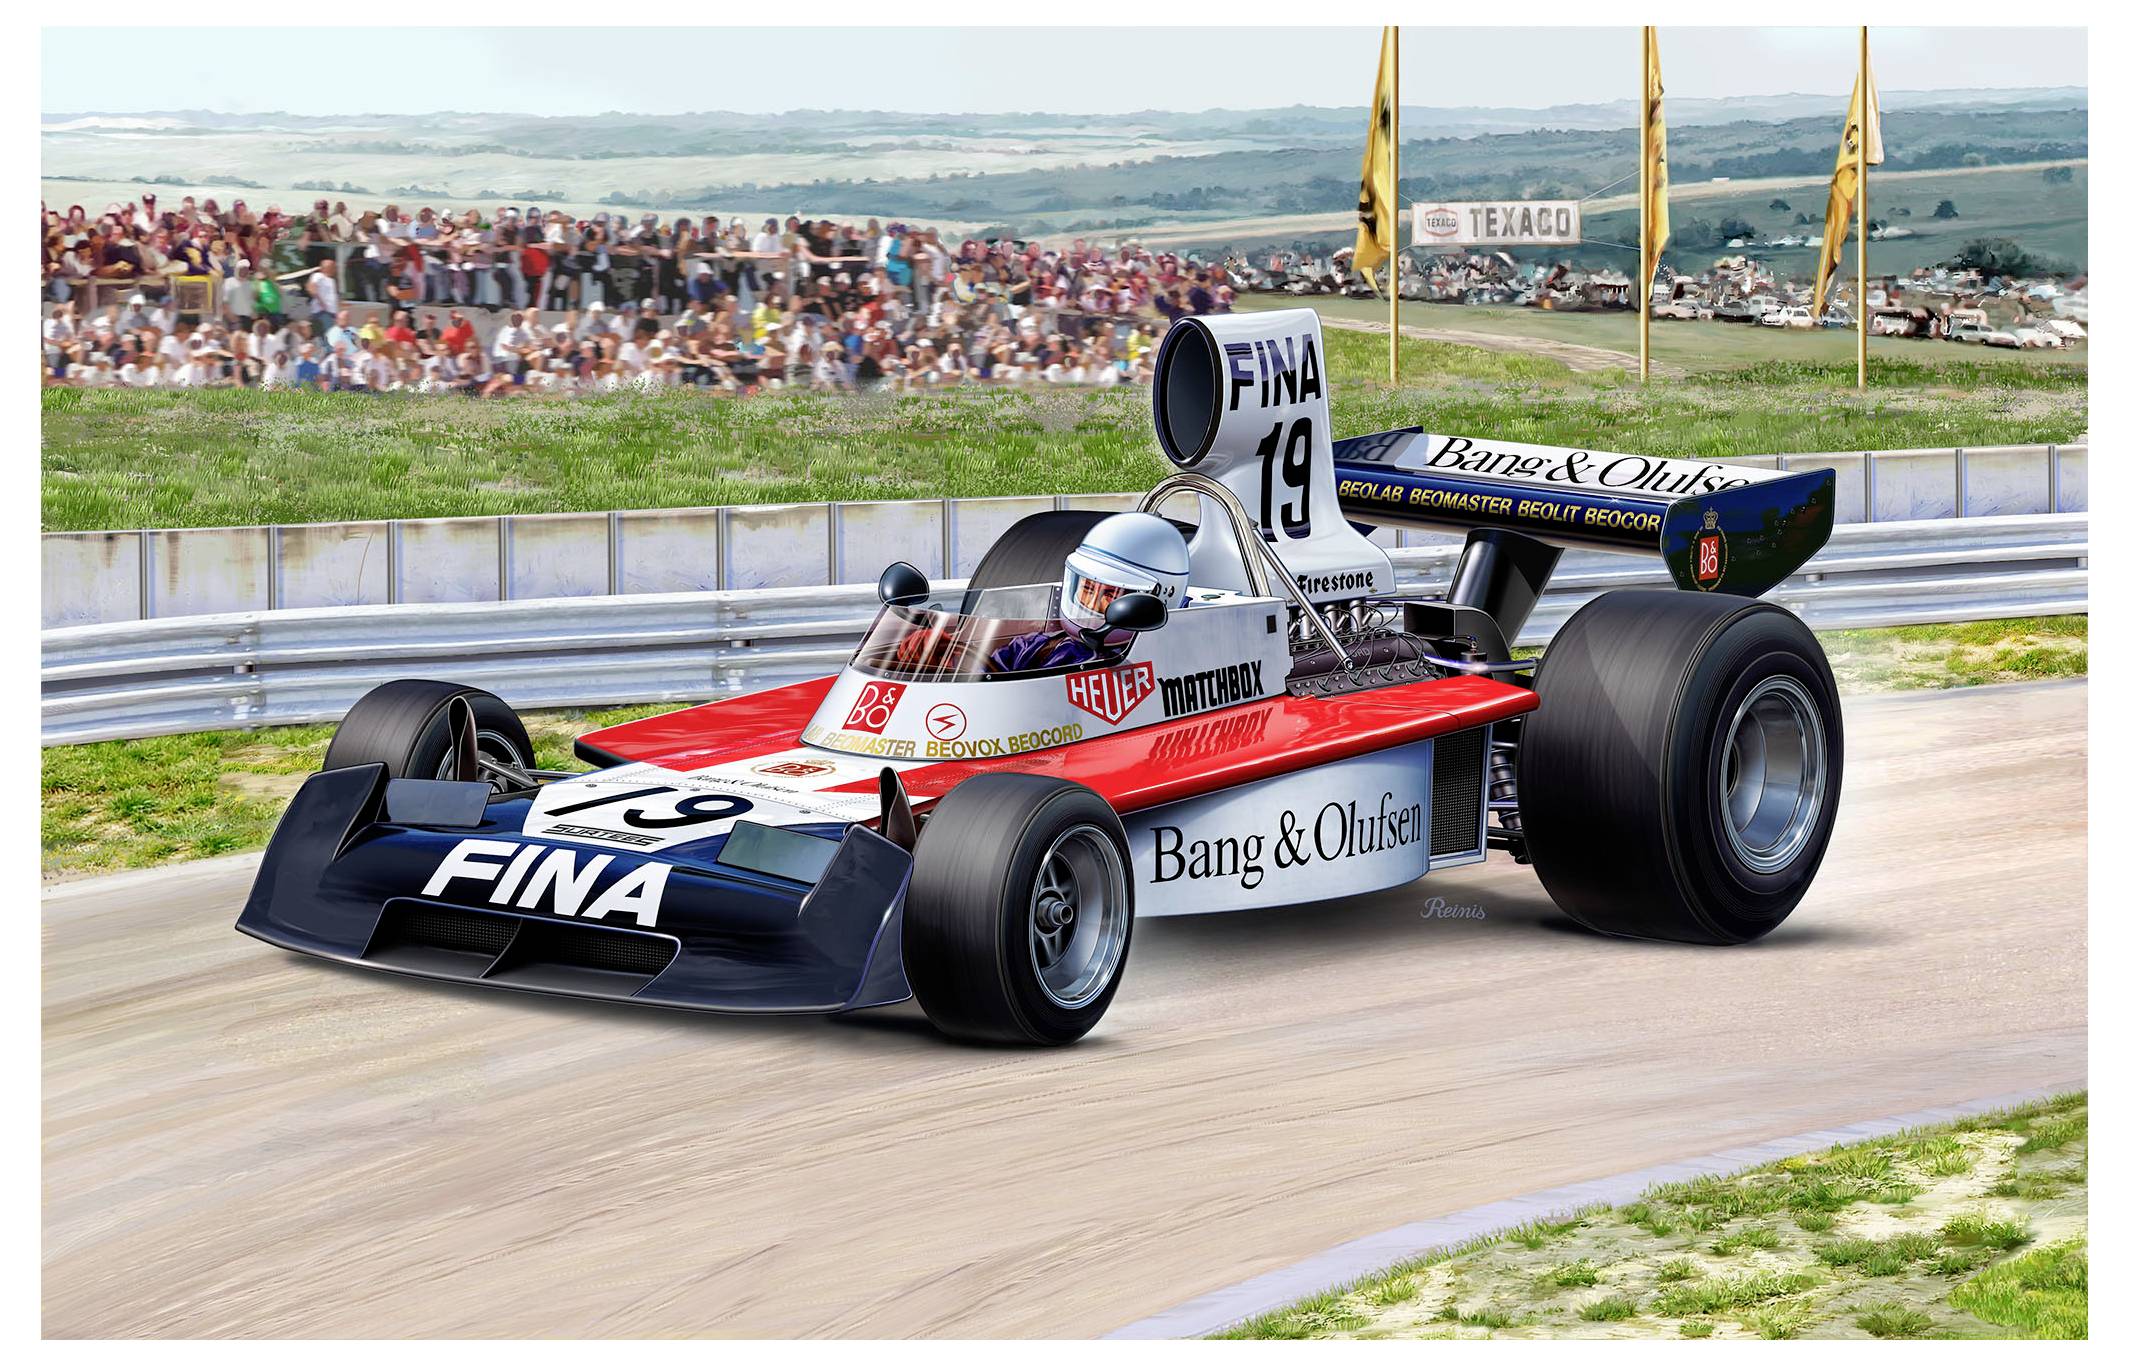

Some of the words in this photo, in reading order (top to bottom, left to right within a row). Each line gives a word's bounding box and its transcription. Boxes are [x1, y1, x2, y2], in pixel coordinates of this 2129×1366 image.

[1427, 217, 1457, 228] TEXACO
[1469, 207, 1571, 238] TEXACO
[1223, 333, 1322, 411] FINA
[1255, 417, 1313, 543] 19
[1425, 437, 1552, 479] Bang
[1545, 452, 1597, 484] &
[1599, 456, 1750, 495] Olufse
[1339, 480, 1404, 503] BEOLAB
[1409, 488, 1513, 515] BEOMASTER
[1517, 498, 1582, 523] BEOLIT
[1585, 507, 1661, 532] BEOCOR
[1297, 571, 1374, 594] Firestone
[1070, 666, 1152, 722] HEUER
[1157, 659, 1265, 717] MATCHBOX
[821, 731, 916, 757] BEOMASTER
[926, 738, 1006, 758] BEOVOX
[1008, 723, 1084, 752] BEOCORD
[543, 786, 754, 829] 19
[541, 823, 666, 847] SURTEES
[1150, 826, 1266, 890] Bang
[1274, 810, 1311, 869] &
[1314, 791, 1421, 862] Olufsen
[421, 838, 674, 928] FINA
